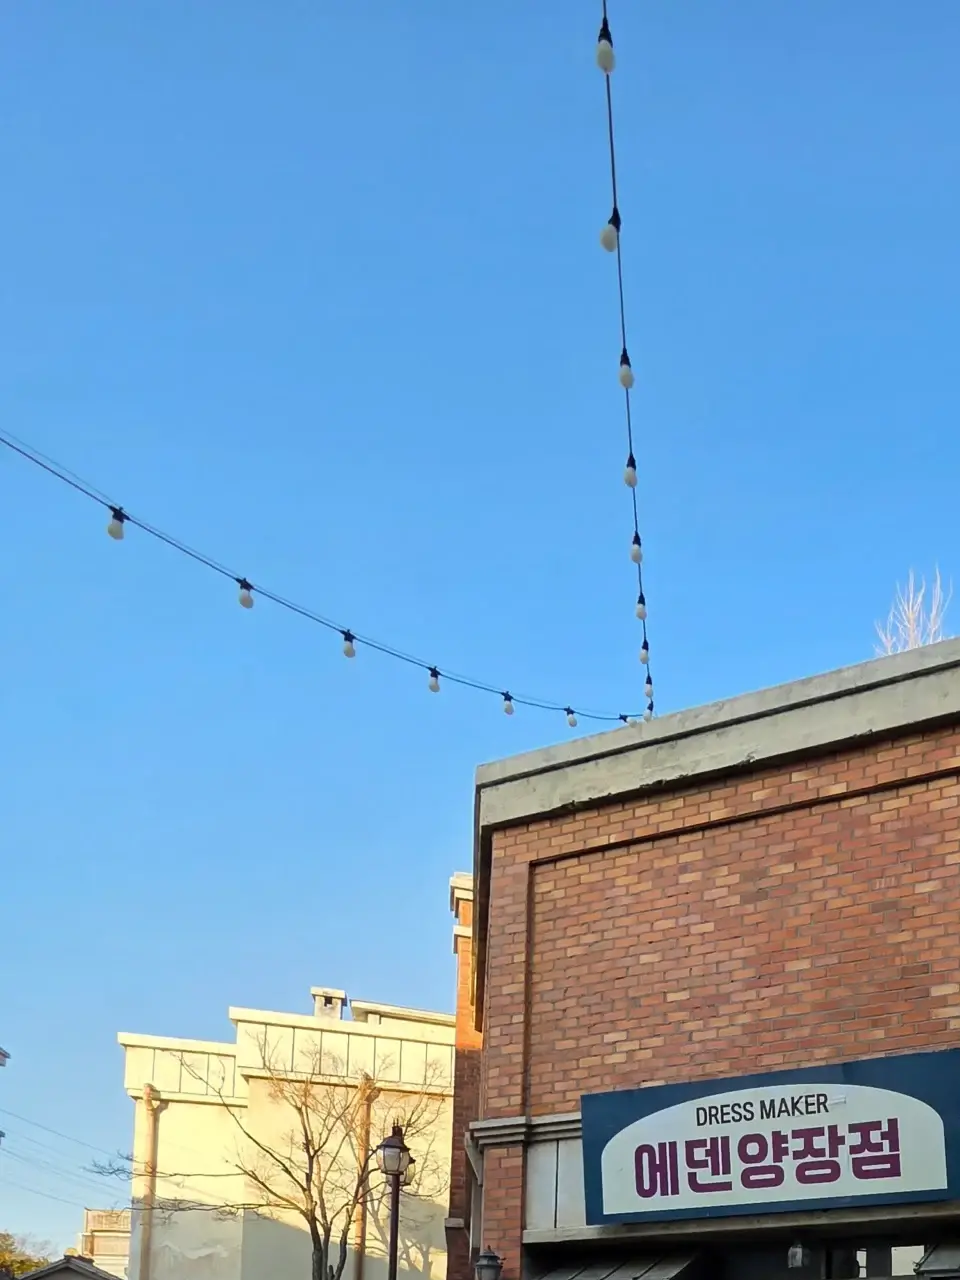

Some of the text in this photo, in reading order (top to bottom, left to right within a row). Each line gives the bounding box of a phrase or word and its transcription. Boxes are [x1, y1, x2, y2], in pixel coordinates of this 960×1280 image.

[696, 1093, 829, 1127] DRESS MAKER
[634, 1117, 901, 1199] 에덴양장점
